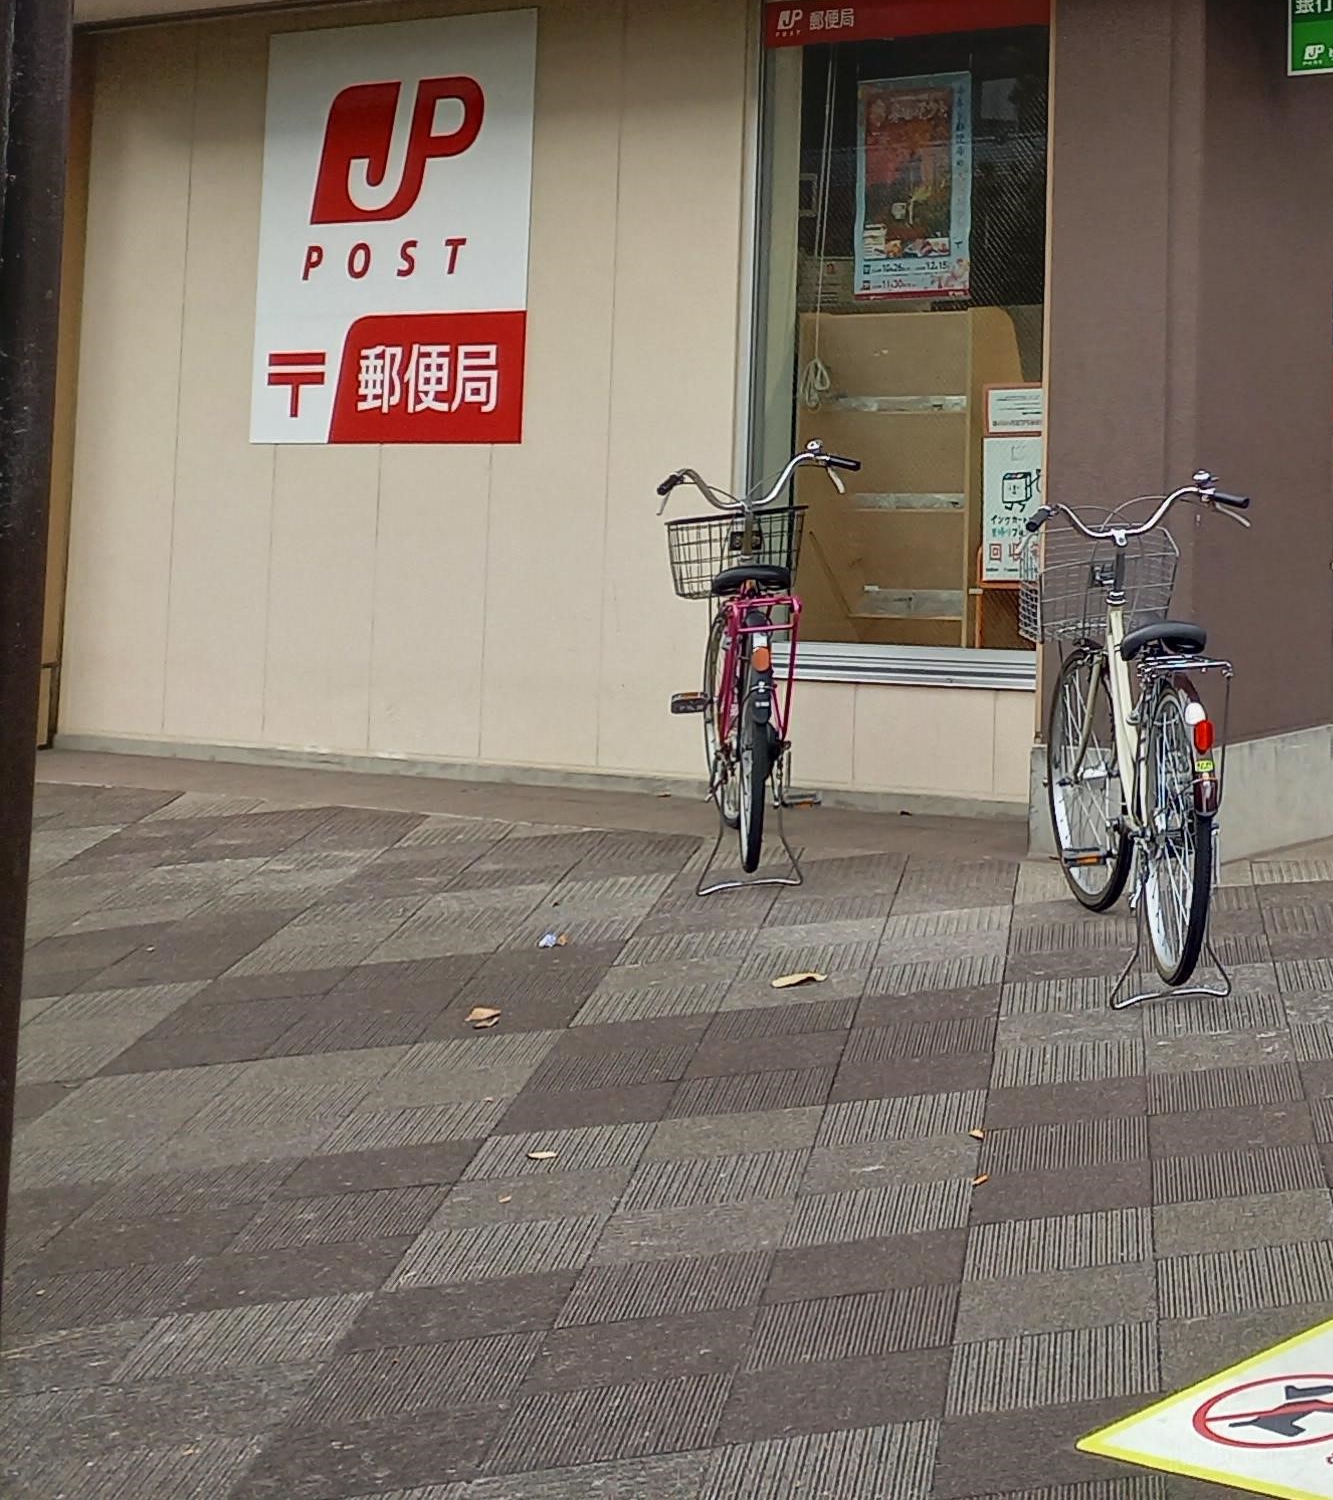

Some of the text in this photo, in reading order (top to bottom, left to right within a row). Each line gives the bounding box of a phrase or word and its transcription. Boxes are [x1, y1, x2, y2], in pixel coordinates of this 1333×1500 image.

[809, 8, 855, 30] 郵便局
[309, 75, 485, 225] JP
[302, 238, 467, 281] POST
[357, 344, 498, 414] 郵便局
